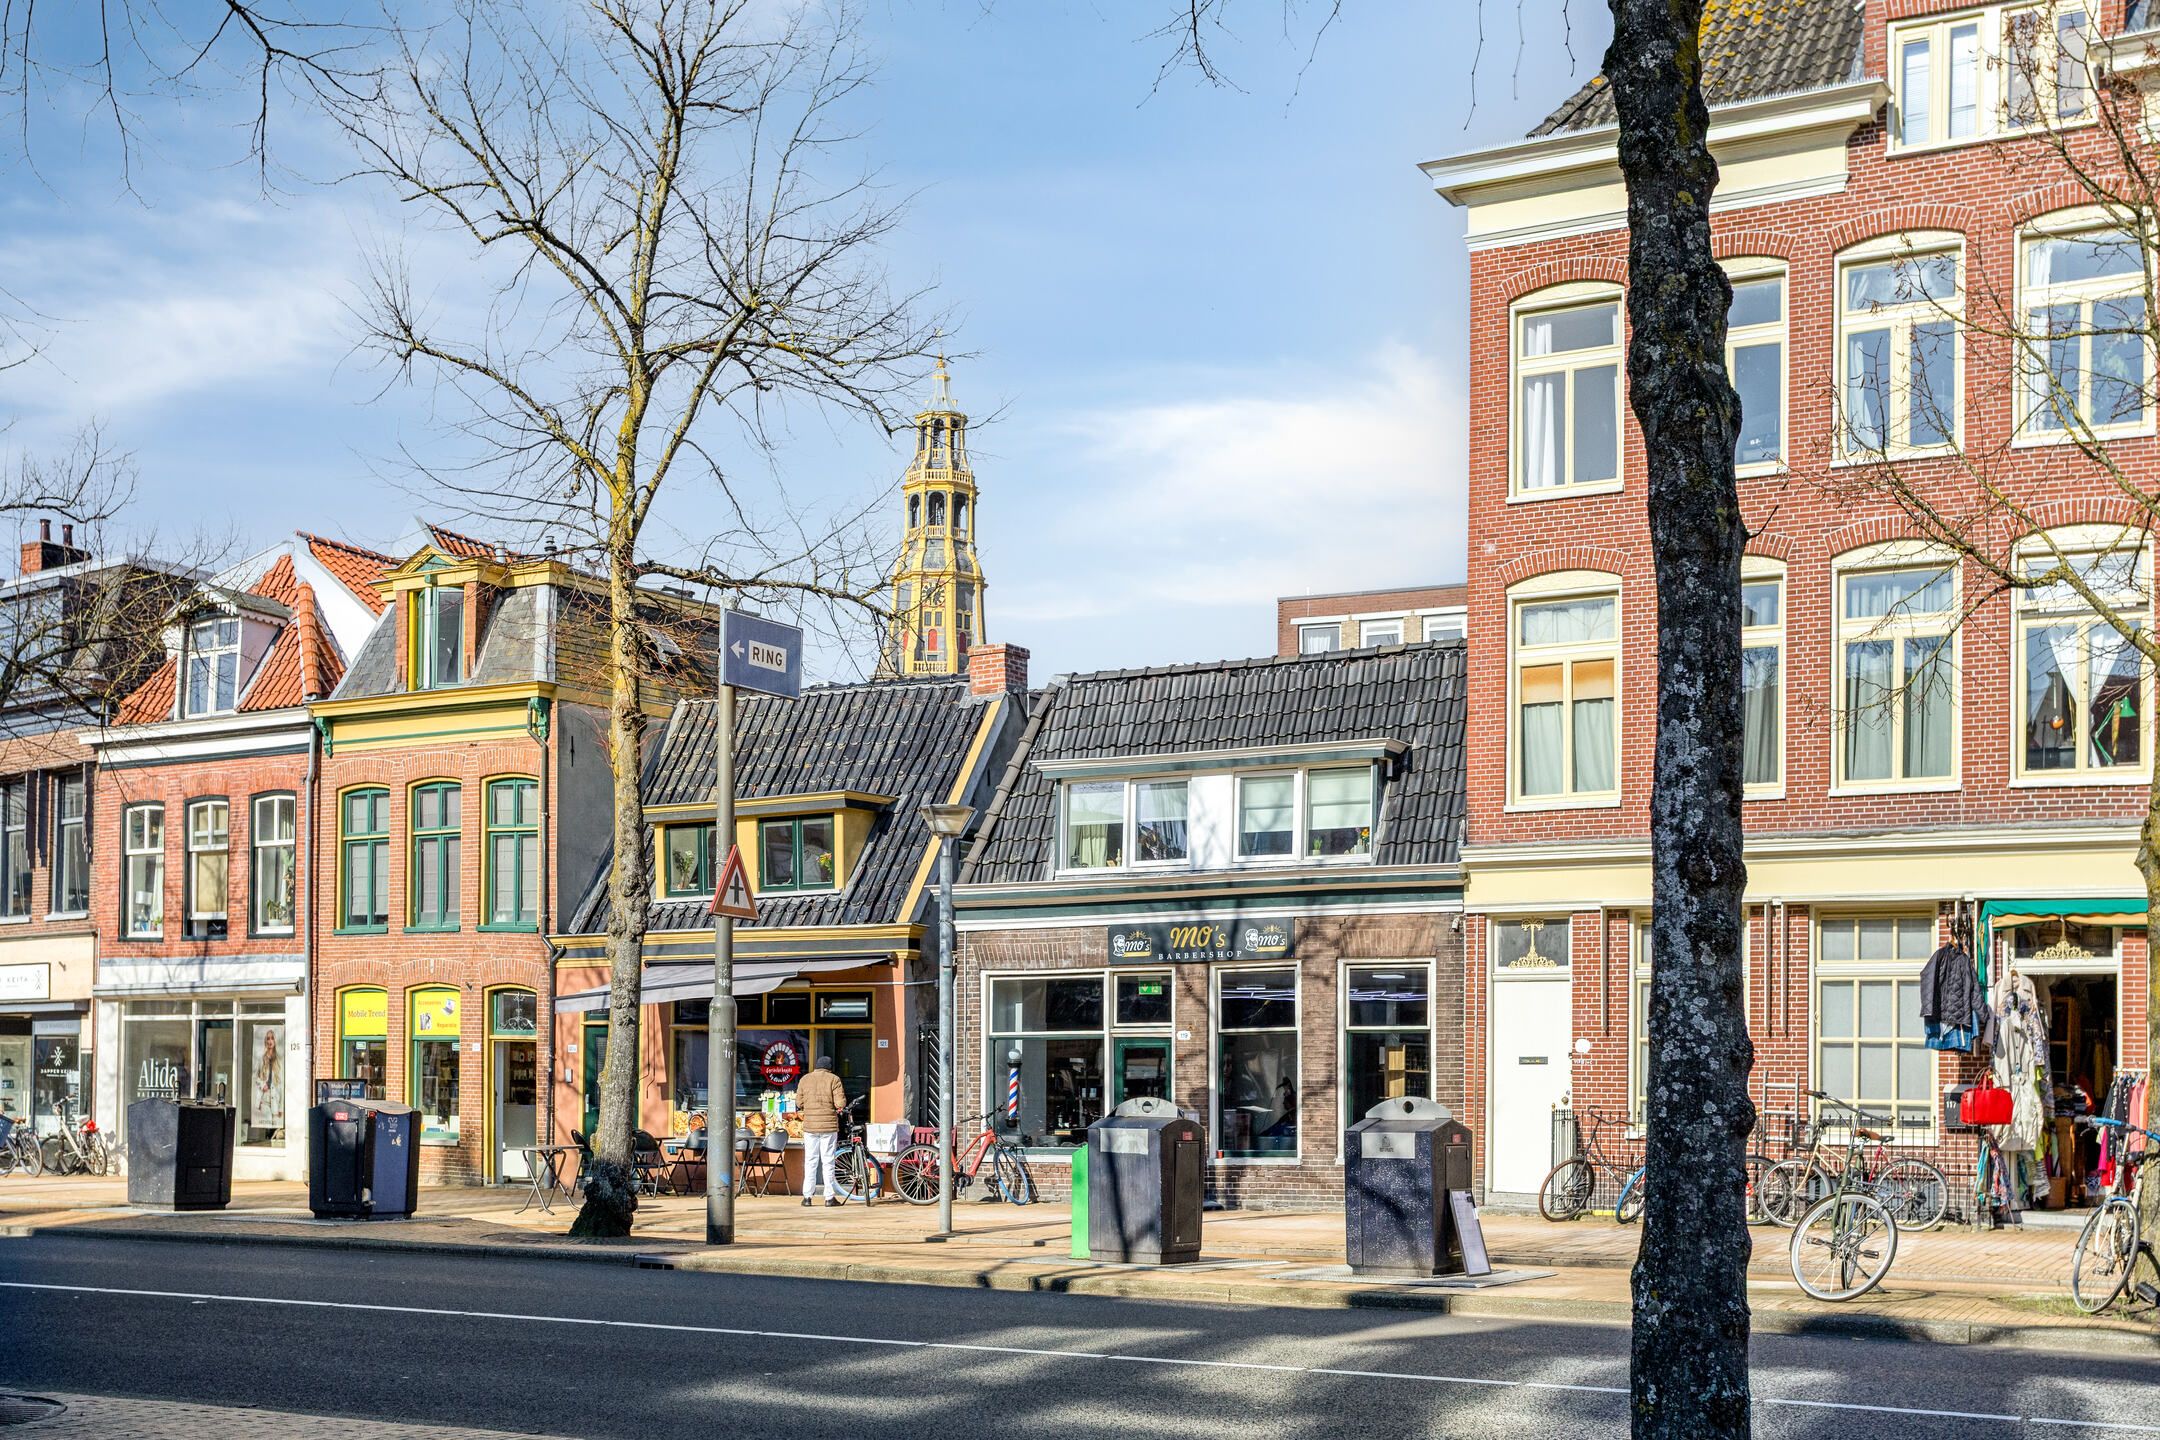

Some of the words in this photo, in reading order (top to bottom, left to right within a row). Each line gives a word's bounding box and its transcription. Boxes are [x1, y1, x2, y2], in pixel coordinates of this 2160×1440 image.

[752, 646, 783, 667] RING
[1158, 951, 1242, 960] BARBERSHOP
[348, 1009, 368, 1018] Mobile
[368, 1009, 386, 1018] Trend
[138, 1057, 179, 1088] Alida
[1946, 1100, 1957, 1109] 117
